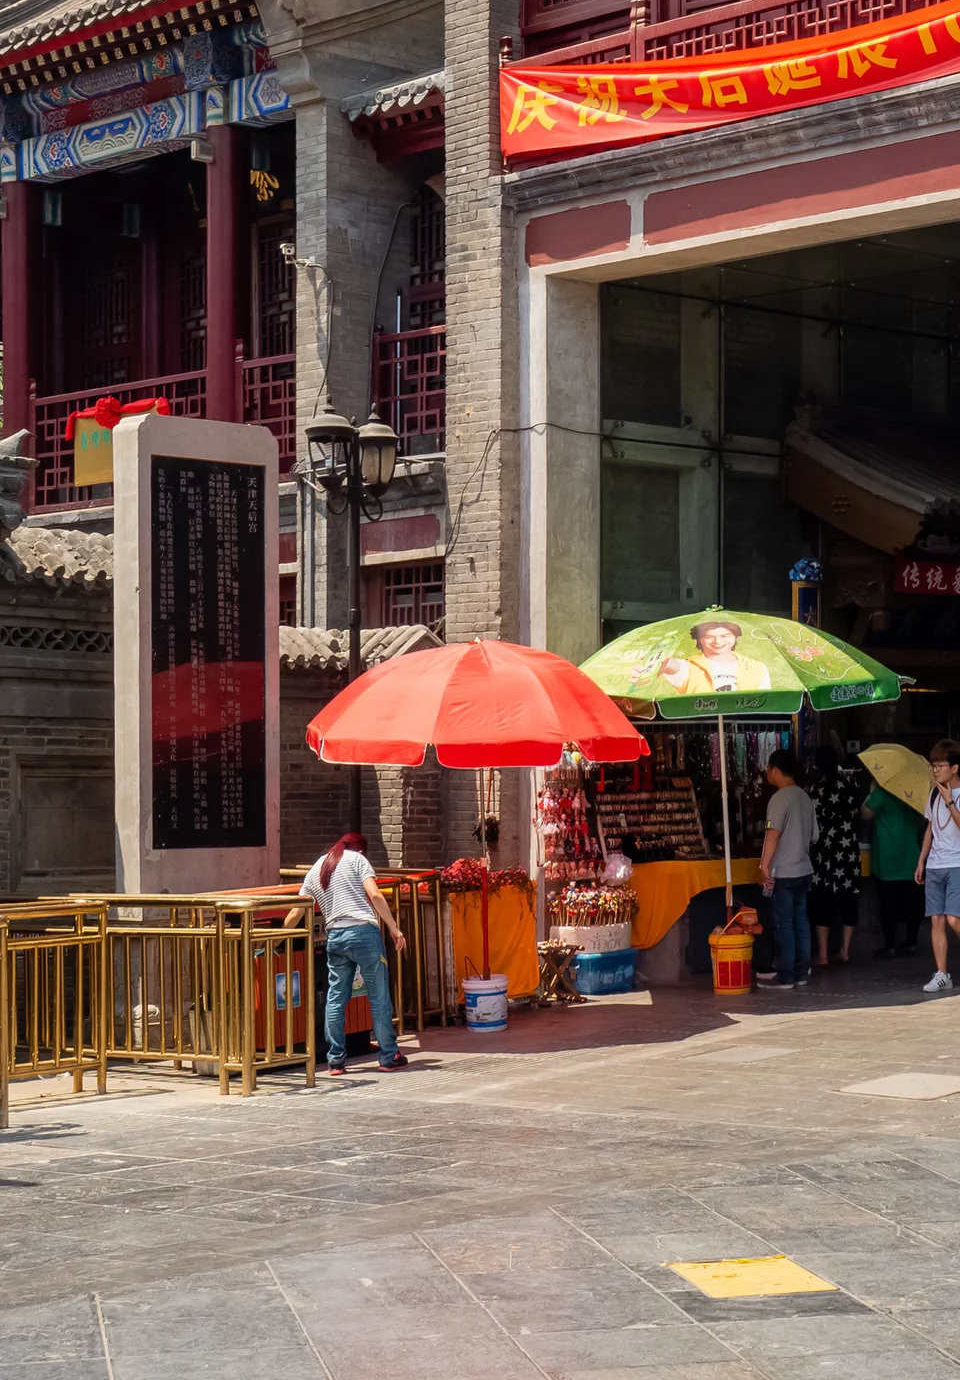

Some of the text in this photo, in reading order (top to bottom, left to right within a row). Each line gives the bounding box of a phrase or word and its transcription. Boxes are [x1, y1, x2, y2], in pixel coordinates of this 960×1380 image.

[247, 476, 259, 533] 天津天后宫
